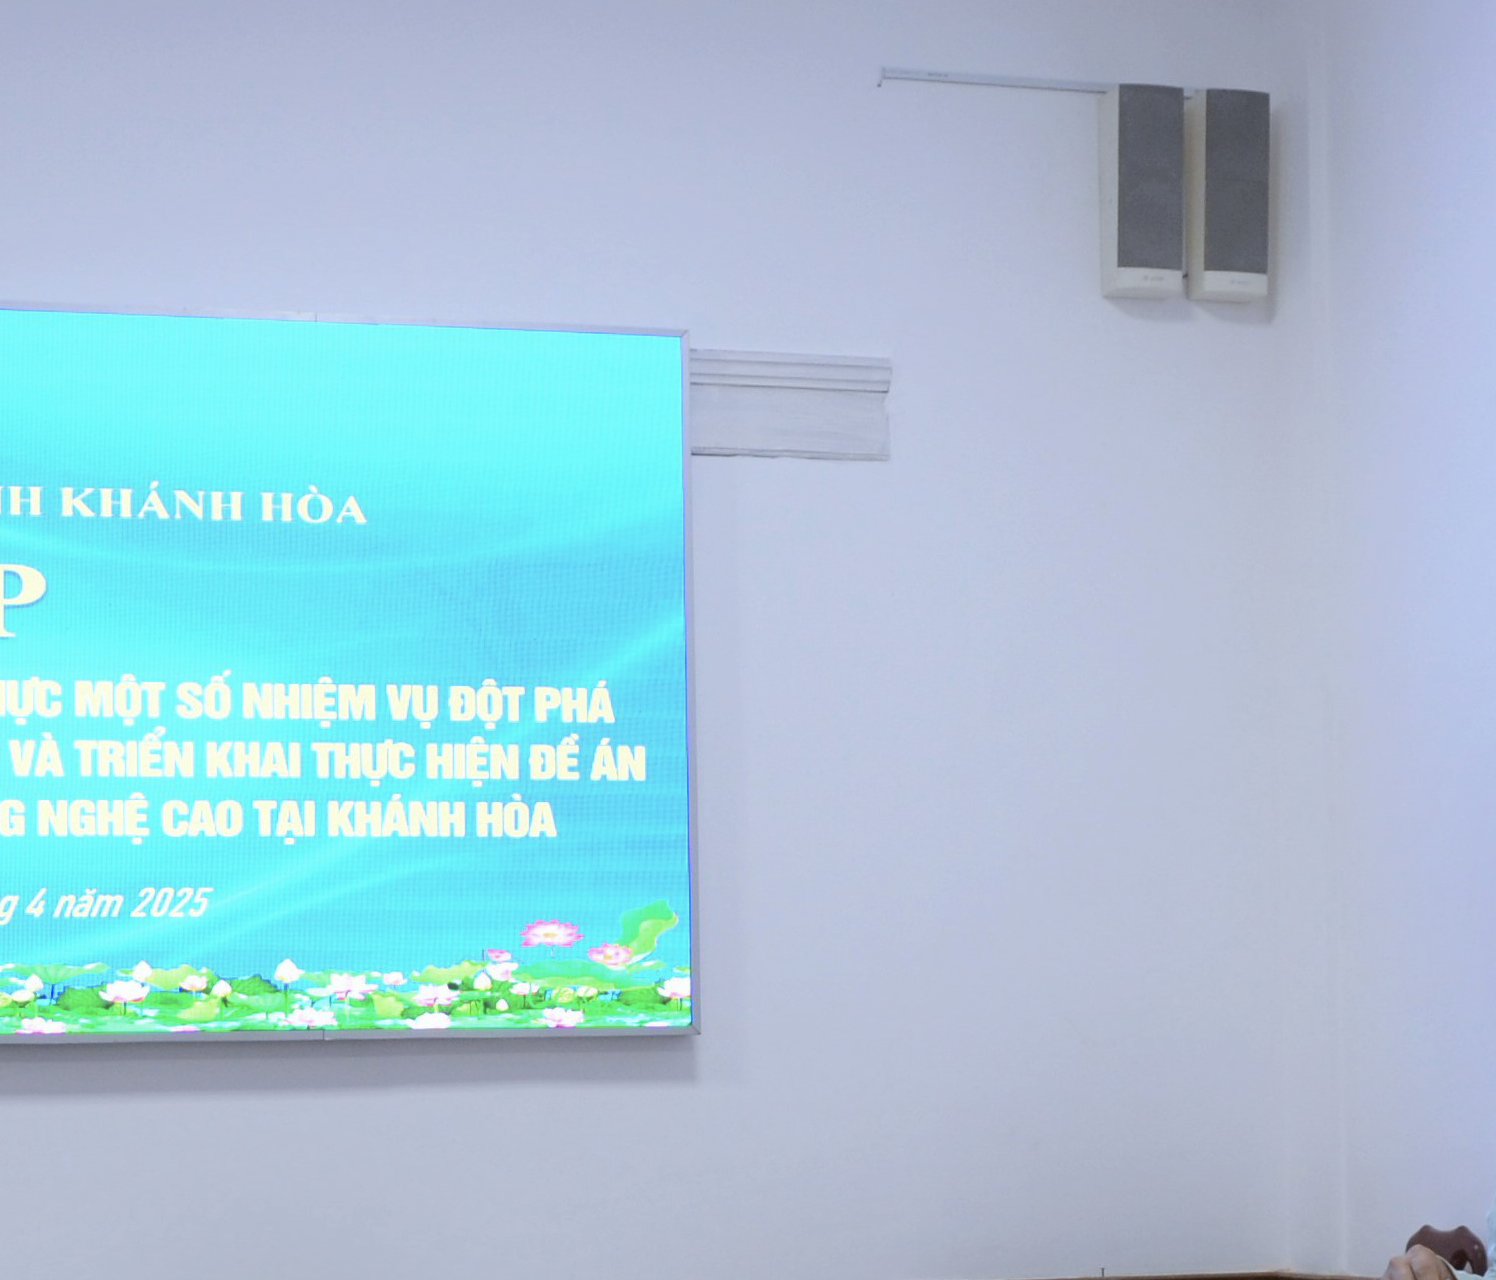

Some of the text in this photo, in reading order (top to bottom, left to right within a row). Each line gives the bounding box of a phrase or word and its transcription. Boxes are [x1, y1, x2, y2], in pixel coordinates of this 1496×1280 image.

[60, 480, 242, 521] KHÁNH
[260, 485, 368, 525] HÒA
[74, 673, 166, 729] MỘT
[176, 669, 232, 720] SỐ
[242, 676, 376, 729] NHIỆM
[386, 684, 438, 729] VỤ
[448, 678, 526, 730] ĐỘT
[534, 680, 616, 723] PHÁ
[8, 731, 64, 777] VÀ
[74, 728, 194, 778] TRIỂN
[206, 741, 301, 778] KHAI
[310, 739, 416, 787] THỰC
[426, 735, 520, 787] HIỆN
[528, 733, 580, 780] ĐỀ
[590, 737, 646, 781] ÁN
[36, 791, 150, 845] NGHỆ
[162, 799, 244, 837] CAO
[252, 799, 316, 845] TẠI
[328, 793, 466, 837] KHÁNH
[476, 793, 558, 838] HÒA
[24, 887, 47, 918] 4
[52, 888, 124, 919] năm
[130, 887, 214, 919] 2025
